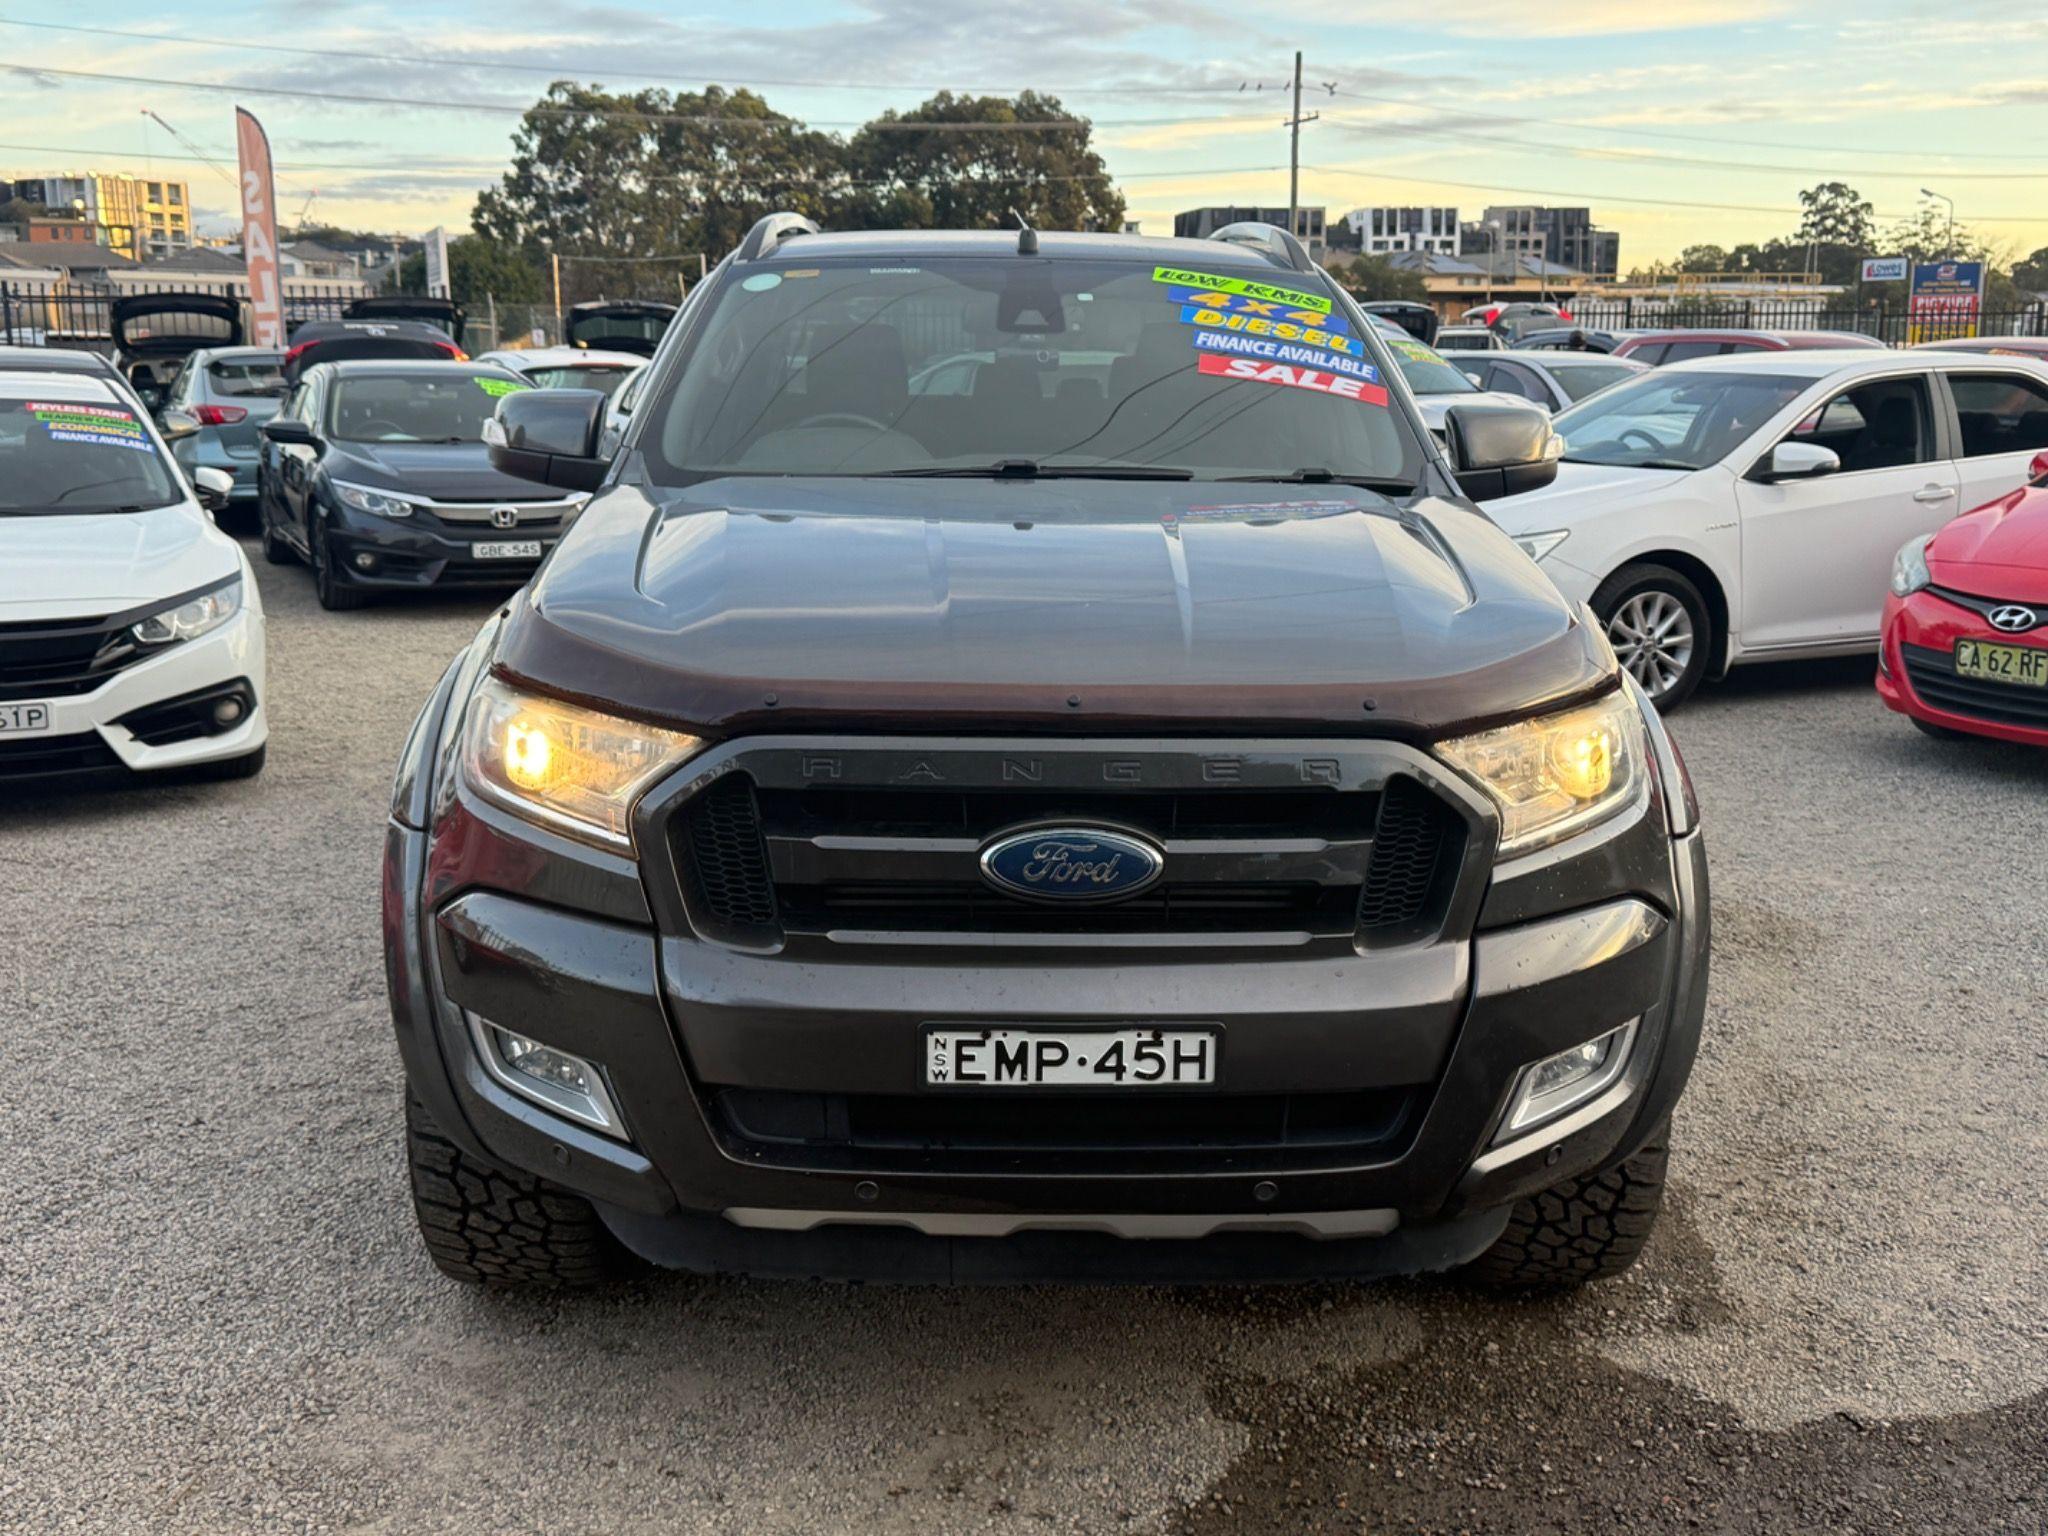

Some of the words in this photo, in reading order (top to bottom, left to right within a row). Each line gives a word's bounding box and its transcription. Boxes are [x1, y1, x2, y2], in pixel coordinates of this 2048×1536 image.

[1158, 269, 1229, 288] LOW
[1243, 283, 1326, 310] KMS
[1192, 308, 1352, 354] DIESEL
[1196, 331, 1281, 357] FINANCE
[1276, 344, 1377, 380] AVAILABLE
[1223, 358, 1366, 399] SALE
[31, 402, 86, 413] KEYLESS
[88, 406, 130, 419] START
[48, 421, 144, 440] ECONOMICAL
[51, 431, 98, 443] FINANCE
[98, 435, 155, 453] AVAILABLE
[802, 755, 1342, 784] RANGER
[1022, 842, 1120, 884] Ford
[932, 1037, 949, 1081] NSW
